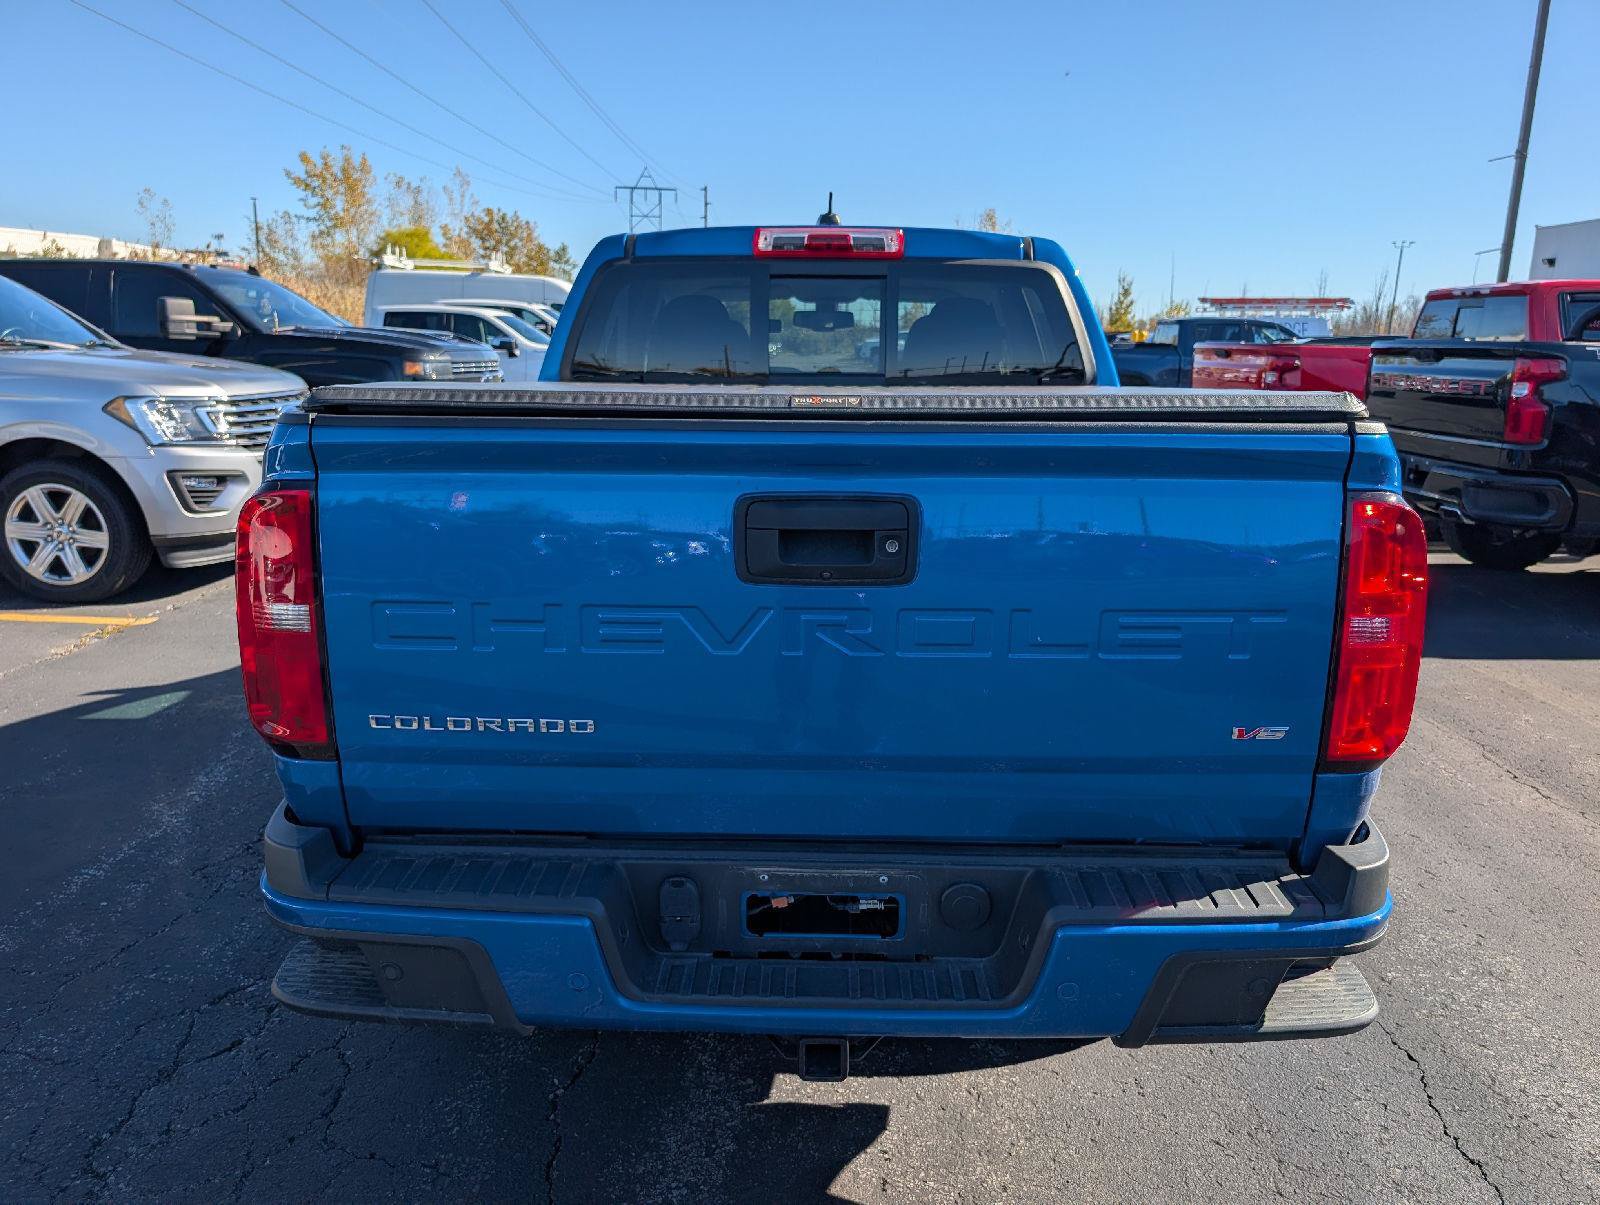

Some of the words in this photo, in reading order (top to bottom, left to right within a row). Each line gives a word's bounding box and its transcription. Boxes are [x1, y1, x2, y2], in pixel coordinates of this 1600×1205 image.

[371, 601, 1288, 660] CHEVROLET
[368, 714, 595, 733] COLORADO
[1232, 726, 1290, 740] V6
